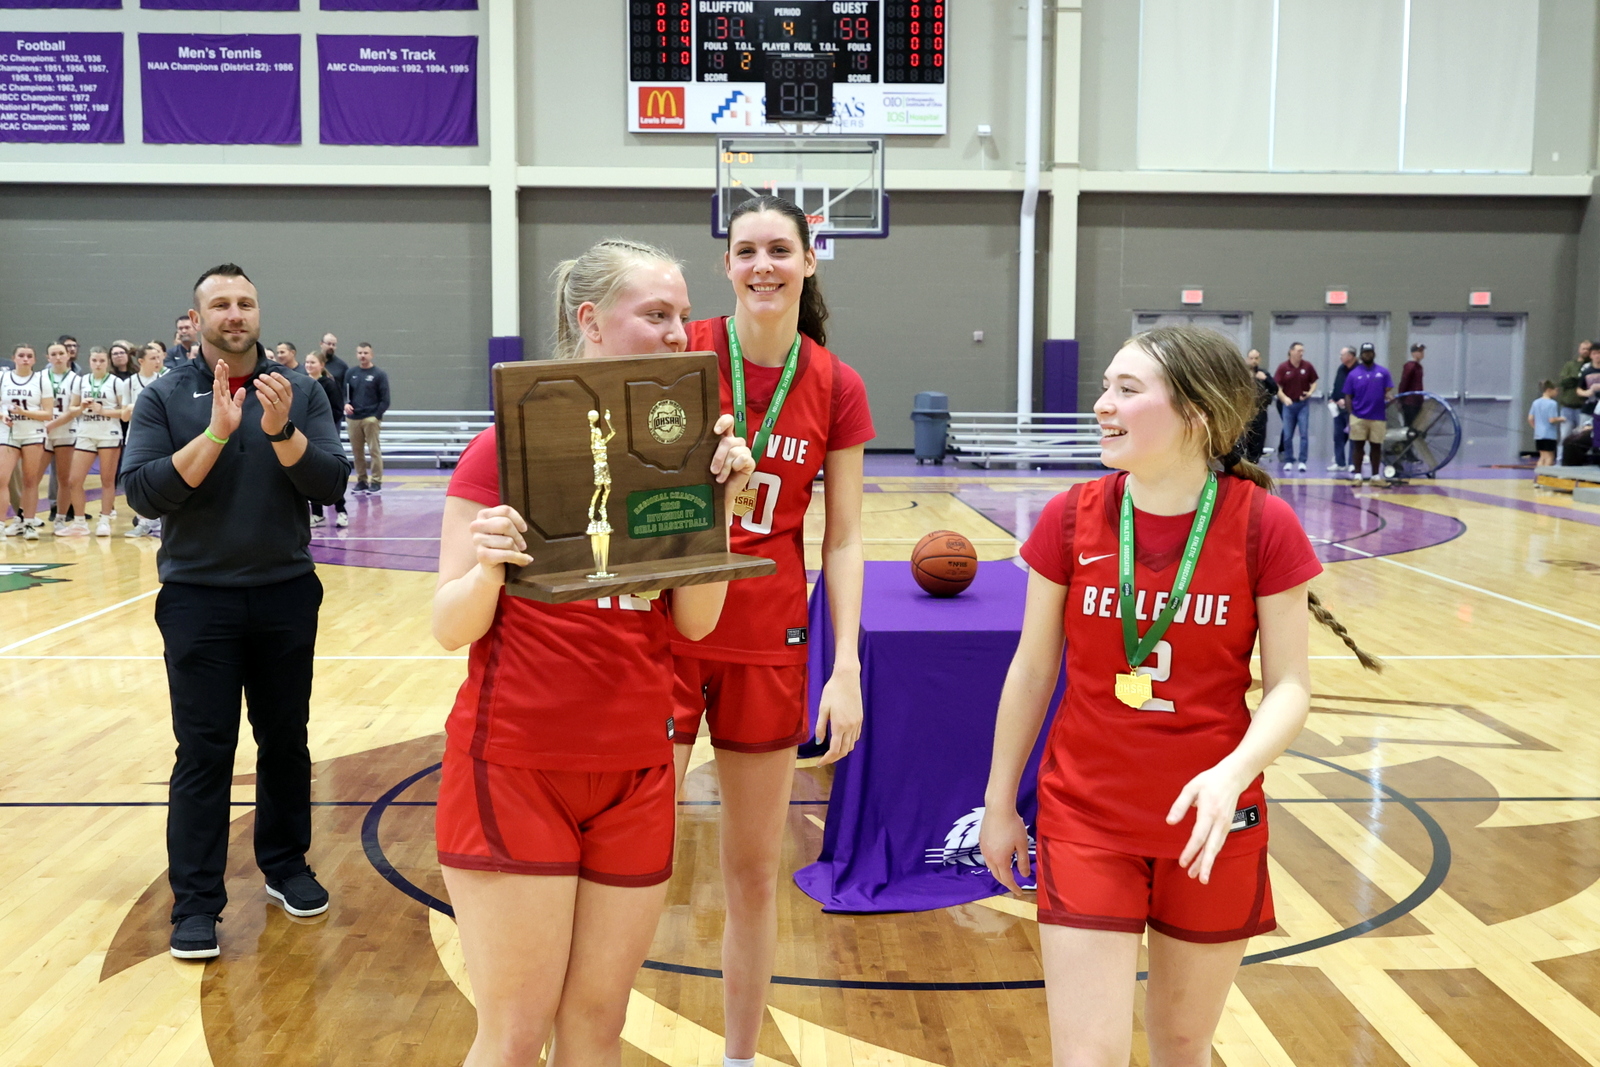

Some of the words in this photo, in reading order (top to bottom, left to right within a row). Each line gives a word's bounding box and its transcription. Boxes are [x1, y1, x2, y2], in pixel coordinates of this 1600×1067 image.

[657, 3, 666, 16] 0
[681, 3, 690, 16] 2
[700, 1, 753, 13] BLUFFTON
[774, 8, 801, 16] PERIOD
[833, 2, 868, 14] GUEST
[716, 17, 744, 39] 31
[783, 22, 794, 35] 4
[840, 18, 869, 40] 59
[17, 40, 65, 50] Football
[704, 42, 728, 50] FOULS
[735, 42, 755, 50] T.O.L.
[762, 42, 790, 51] PLAYER
[794, 43, 813, 51] FOUL
[819, 43, 839, 51] T.O.L.
[847, 43, 872, 51] FOULS
[10, 54, 56, 63] Champions:
[178, 47, 216, 59] Men's
[219, 47, 262, 59] Tennis
[360, 48, 397, 60] Men's
[401, 49, 436, 60] Track
[741, 52, 751, 70] 2
[148, 62, 169, 70] NAIA
[171, 62, 218, 72] Champions
[221, 63, 253, 72] (District
[349, 63, 399, 73] Champions:
[402, 64, 423, 73] 1992,
[426, 65, 447, 73] 1994,
[704, 74, 728, 82] SCORE
[848, 74, 872, 83] SCORE
[9, 84, 55, 92] Champions:
[21, 94, 67, 102] Champions:
[31, 104, 65, 112] Playoffs:
[21, 113, 66, 122] Champions:
[661, 117, 683, 125] Family
[22, 123, 68, 132] Champions:
[655, 416, 680, 426] OHSAA
[634, 492, 669, 515] REGIONAL
[670, 492, 706, 509] CHAMPION
[1202, 502, 1210, 513] HIGH
[646, 510, 684, 522] DIVISION
[634, 524, 657, 534] GIRLS
[658, 517, 708, 532] BASKETBALL
[1196, 515, 1206, 532] SCHOOL
[1188, 536, 1200, 558] ATHLETIC
[1178, 560, 1192, 590] ASSOCIATION
[1134, 638, 1176, 713] 2
[1117, 683, 1150, 697] OHSAA
[1250, 812, 1256, 821] S
